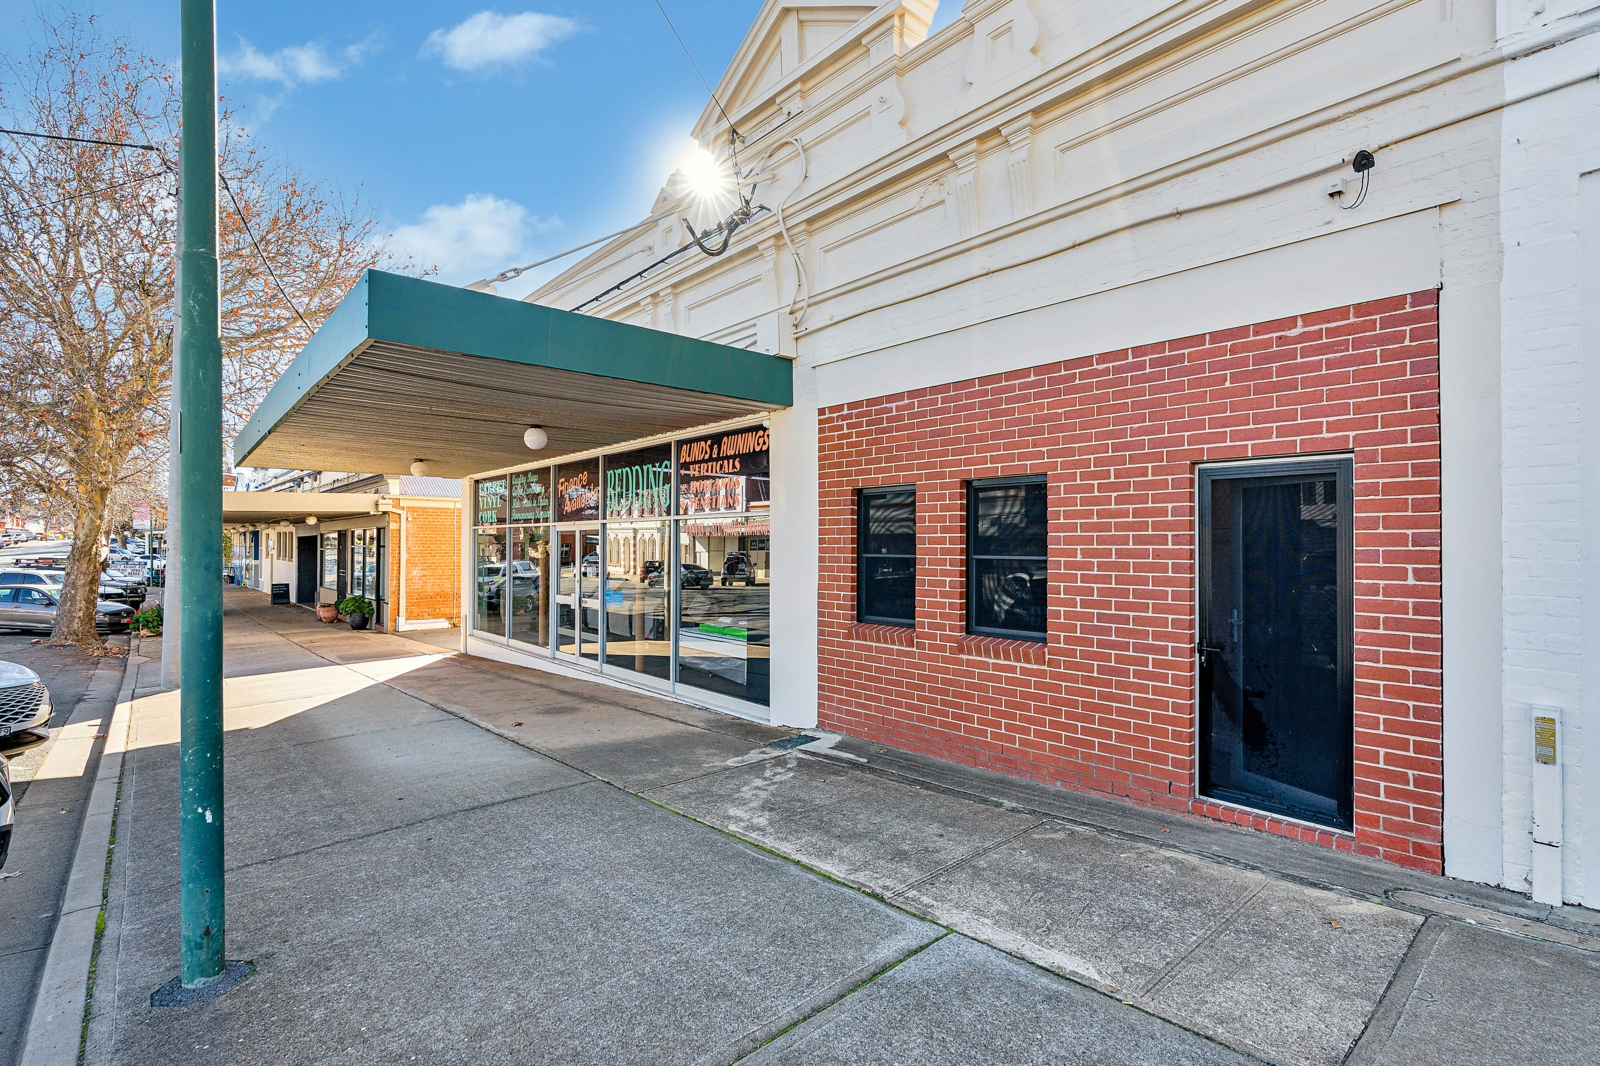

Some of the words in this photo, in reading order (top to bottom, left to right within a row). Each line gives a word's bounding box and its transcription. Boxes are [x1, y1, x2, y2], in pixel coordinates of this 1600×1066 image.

[680, 440, 712, 463] BLINDS
[712, 444, 719, 458] &
[720, 429, 770, 457] AWNINGS
[689, 458, 740, 477] VERTICALS
[479, 479, 507, 495] CARPET
[557, 471, 588, 498] Finance
[606, 460, 671, 512] BEDDING
[689, 475, 740, 493] HOLLANDS
[479, 496, 501, 509] VINYL
[563, 483, 599, 515] Available
[689, 493, 740, 510] VENETIANS
[478, 510, 498, 523] CORK
